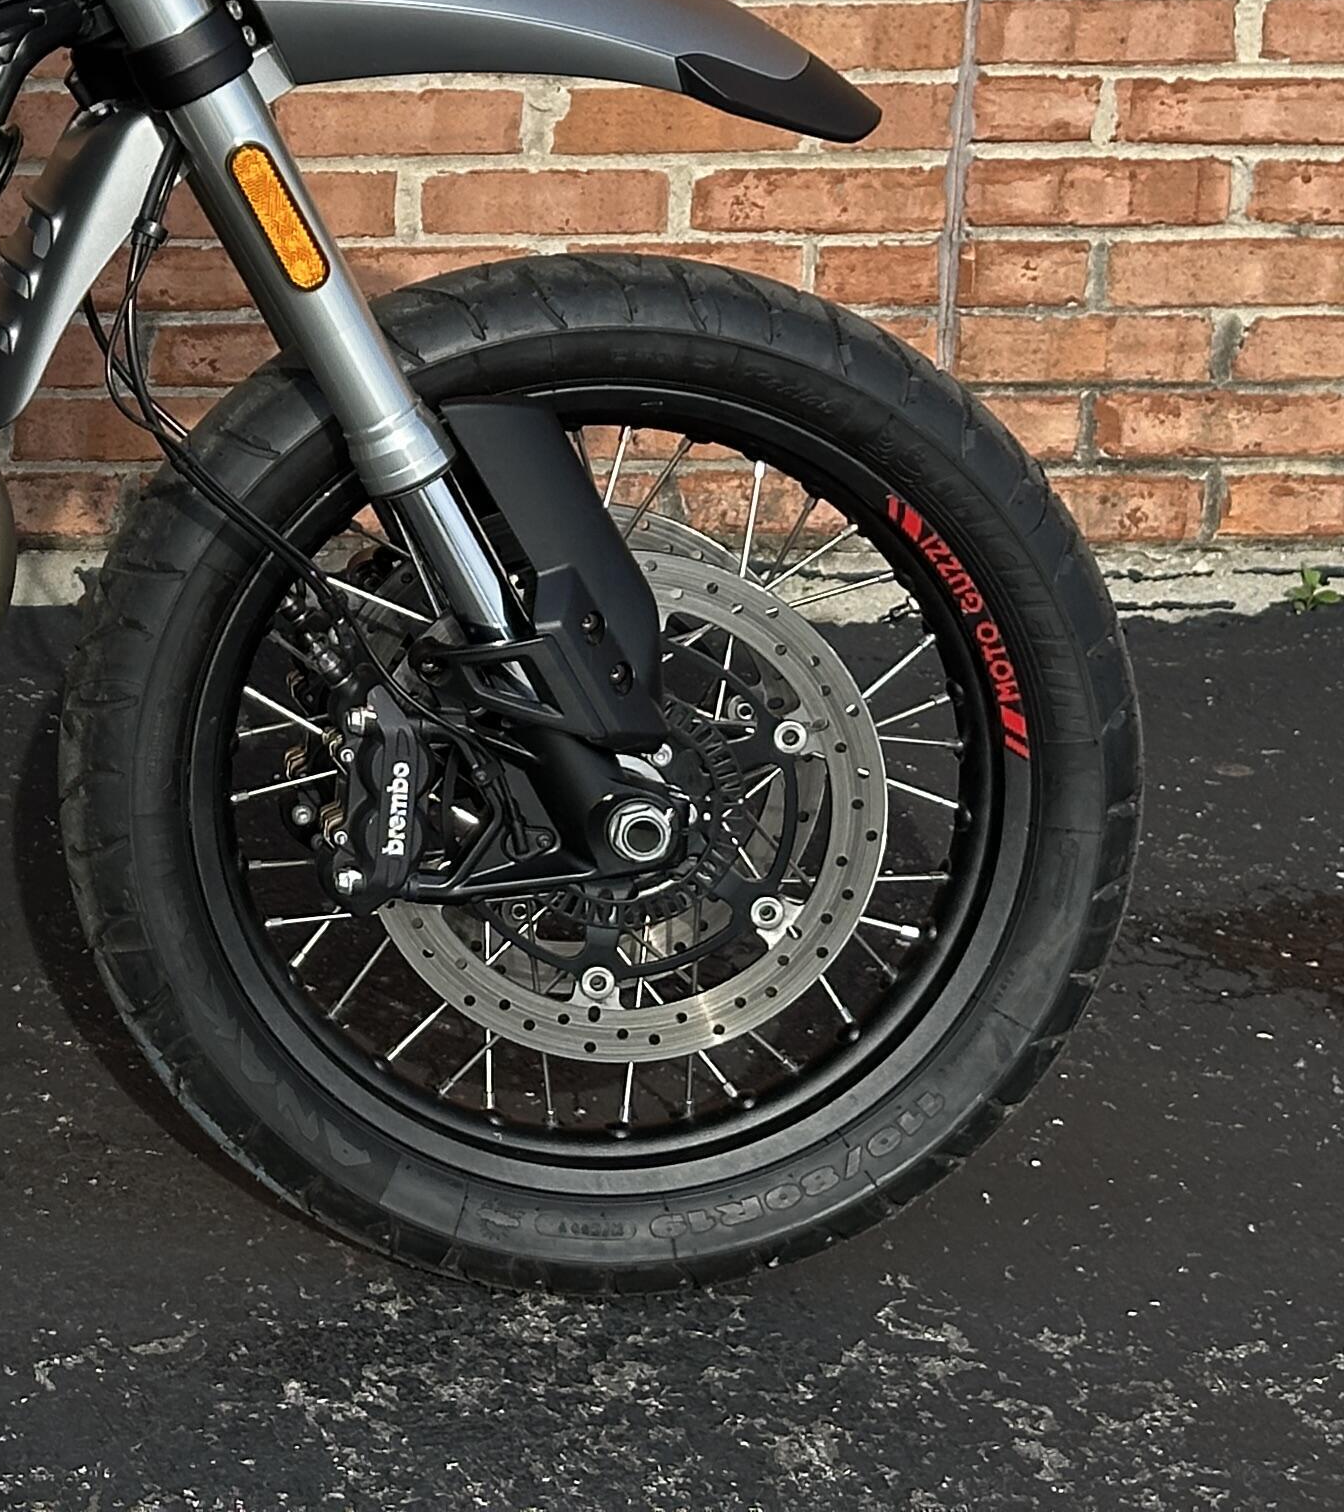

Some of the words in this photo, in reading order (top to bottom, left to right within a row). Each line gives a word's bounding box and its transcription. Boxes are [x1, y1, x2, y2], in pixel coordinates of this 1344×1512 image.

[920, 532, 984, 615] GUZZI
[976, 620, 1021, 703] MOTO
[381, 761, 410, 856] brembo
[650, 1083, 949, 1240] 110/80R19
